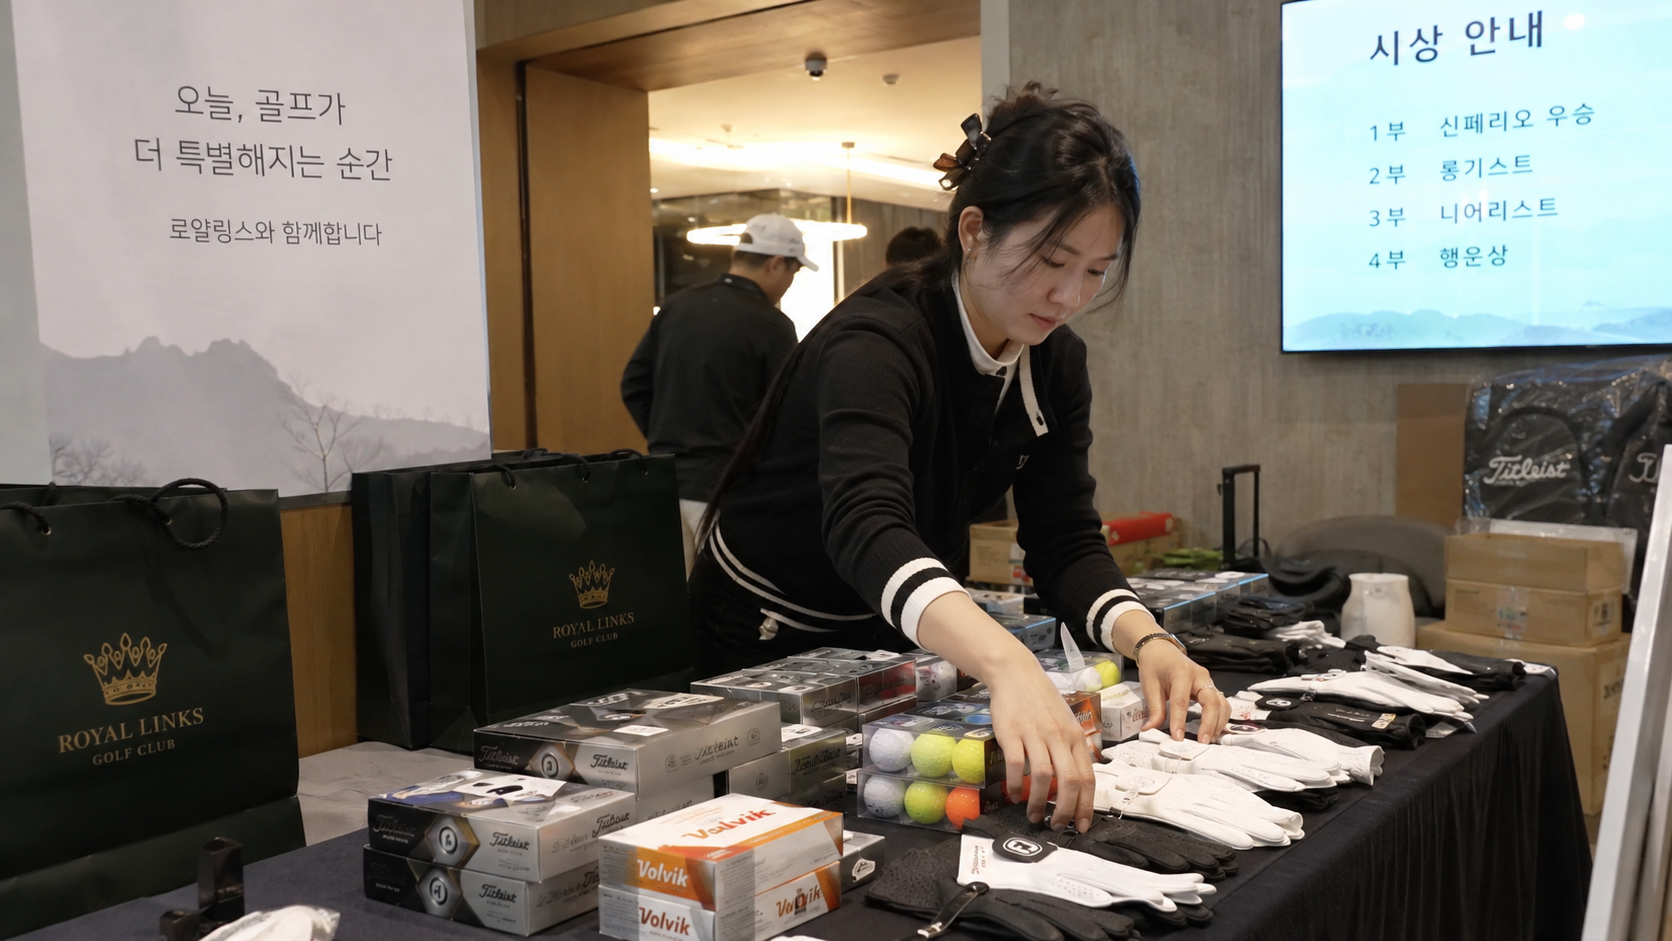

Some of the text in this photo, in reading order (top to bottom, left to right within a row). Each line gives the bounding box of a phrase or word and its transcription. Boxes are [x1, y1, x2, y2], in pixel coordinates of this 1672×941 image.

[1369, 9, 1544, 67] 시상 안내
[174, 85, 347, 126] 오늘, 골프가
[1440, 109, 1535, 138] 신페리오
[1546, 102, 1596, 127] 우승
[134, 137, 394, 182] 더 특별해지는 순간
[1440, 154, 1534, 182] 롱기스트
[1440, 197, 1559, 225] 니어리스트
[169, 218, 383, 247] 로얄링스와 함께합니다
[1439, 244, 1509, 270] 행운상
[1482, 454, 1571, 486] Titleist
[552, 611, 636, 640] ROYAL LINKS
[570, 631, 619, 649] GOLF CLUB
[57, 707, 205, 754] ROYAL LINKS
[92, 738, 176, 766] GOLF CLUB
[637, 859, 690, 888] Volvik
[638, 906, 691, 936] Volvik
